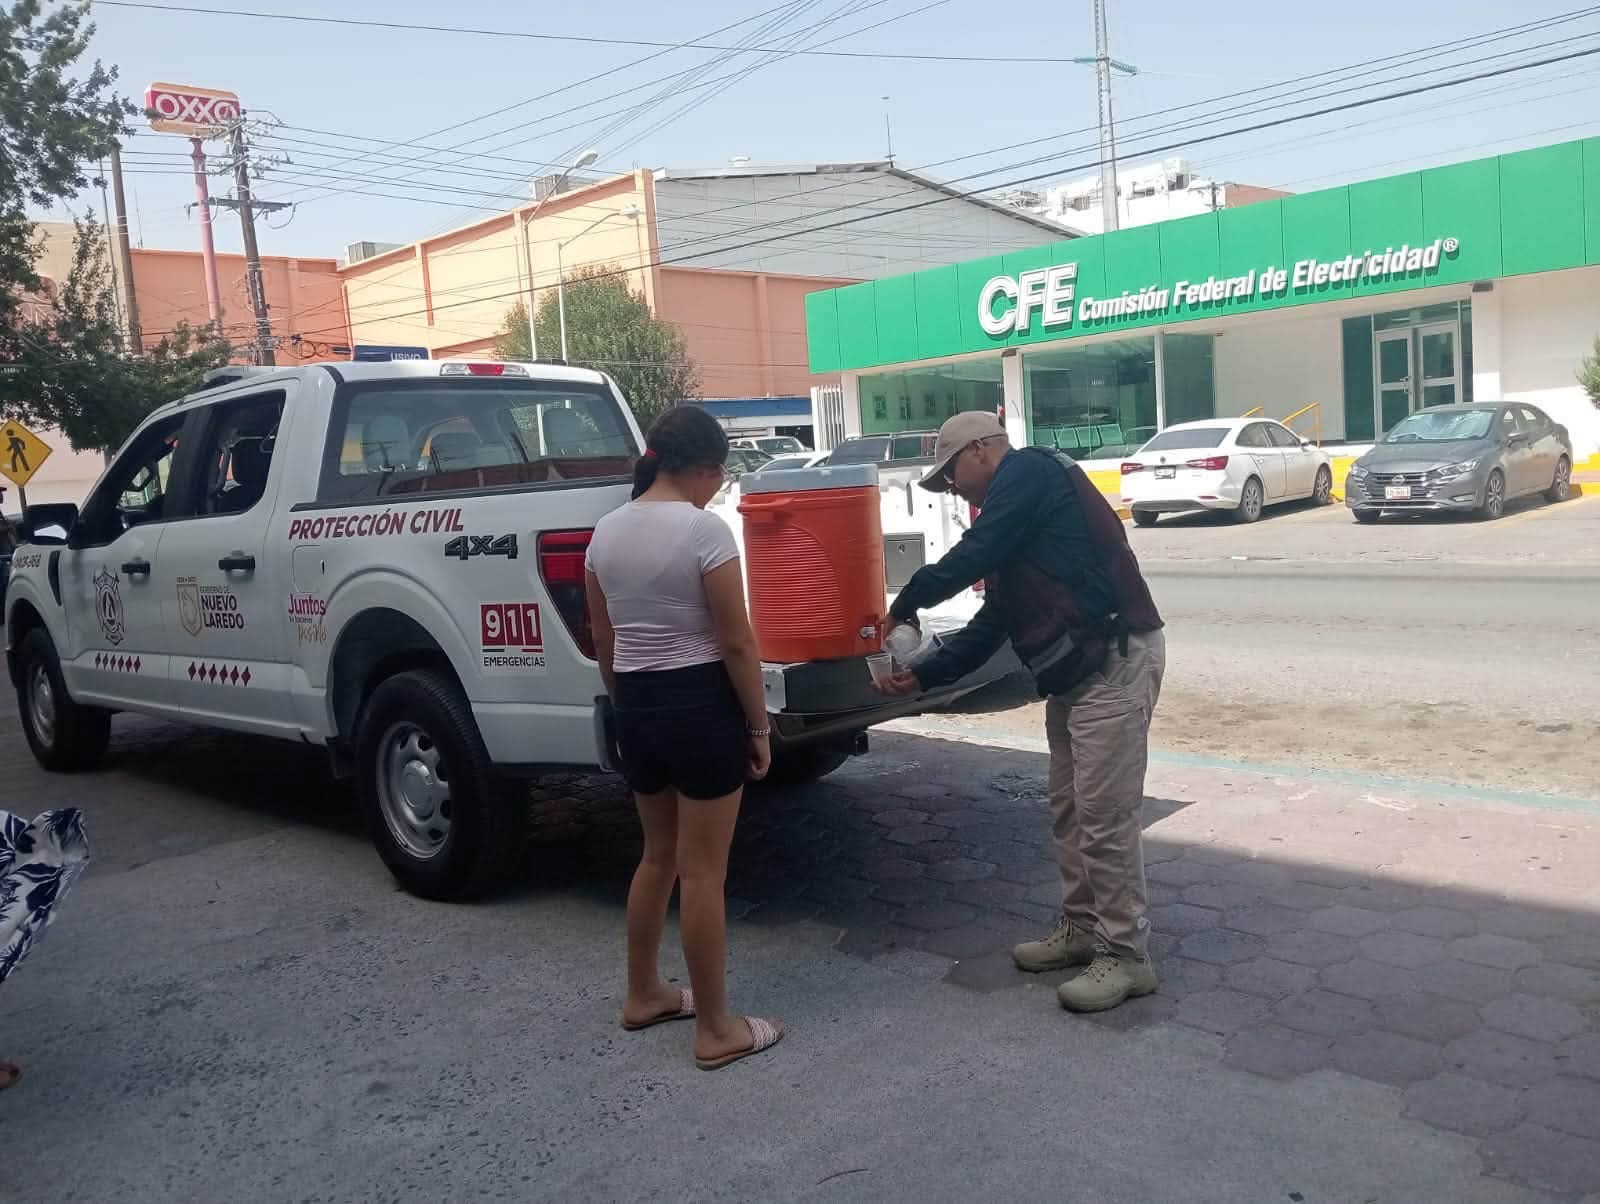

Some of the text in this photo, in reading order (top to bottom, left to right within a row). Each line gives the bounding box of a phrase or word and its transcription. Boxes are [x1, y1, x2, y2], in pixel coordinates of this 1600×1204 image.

[155, 93, 238, 125] OXXO
[978, 262, 1078, 335] CFE
[1078, 284, 1170, 321] Comisión
[1172, 269, 1257, 307] Federal
[1258, 265, 1288, 293] de
[288, 508, 465, 540] PROTECCIÓN CIVIL
[200, 594, 238, 611] NUEVO
[287, 593, 327, 617] Juntos
[202, 612, 245, 629] LAREDO
[485, 608, 538, 638] 911
[483, 656, 546, 667] EMERGENCIAS
